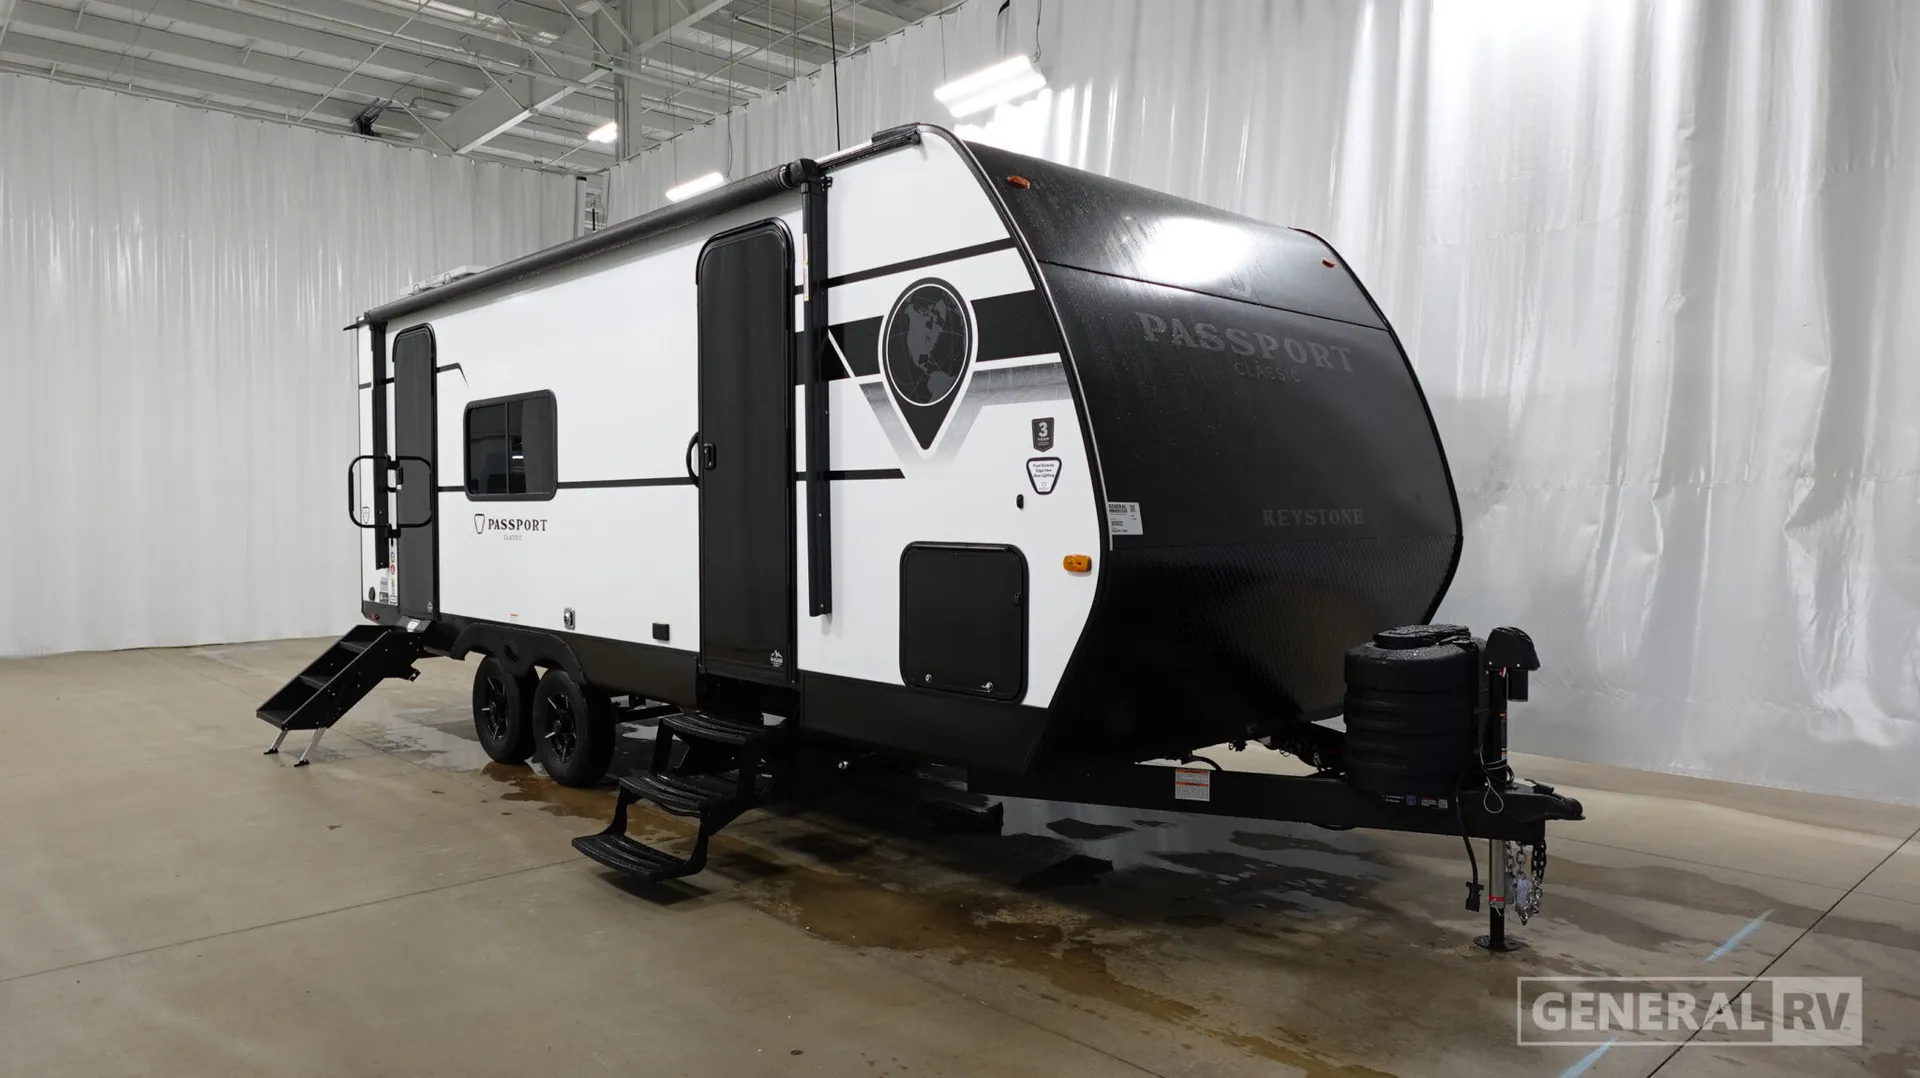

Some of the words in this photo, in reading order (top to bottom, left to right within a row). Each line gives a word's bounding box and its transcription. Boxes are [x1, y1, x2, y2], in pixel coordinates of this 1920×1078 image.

[1136, 311, 1354, 372] PASSPORT
[1234, 362, 1301, 383] CLASSIC
[1038, 421, 1048, 437] 3
[488, 518, 548, 532] PASSPORT
[1262, 509, 1365, 527] KEYSTONE
